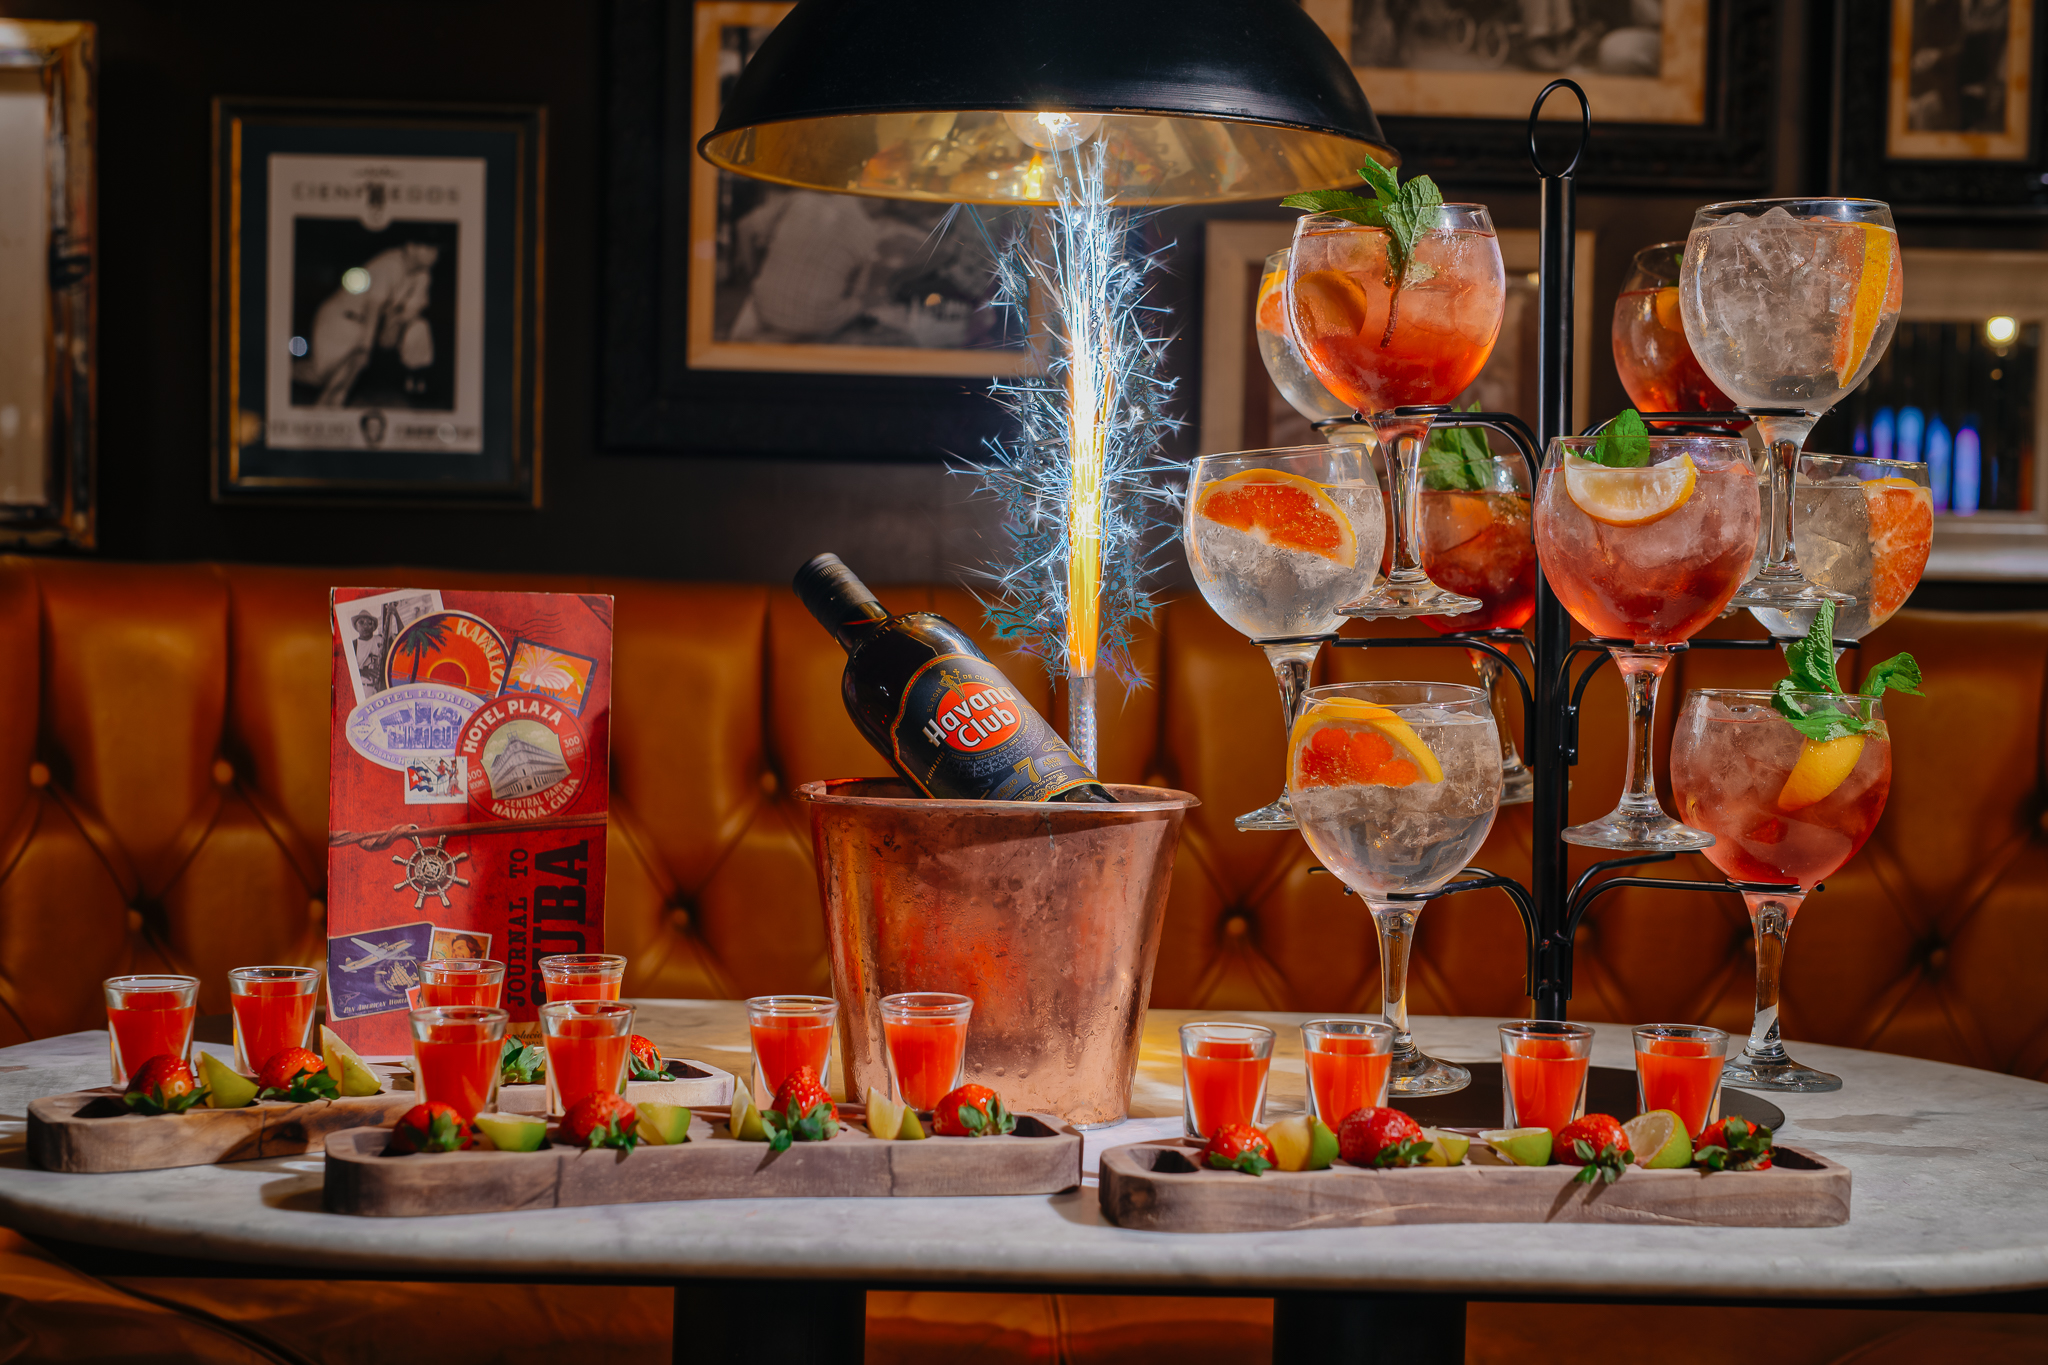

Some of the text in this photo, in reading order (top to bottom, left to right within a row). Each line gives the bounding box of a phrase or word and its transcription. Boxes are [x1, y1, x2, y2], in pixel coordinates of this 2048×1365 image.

[975, 674, 994, 684] CUBA
[365, 690, 480, 715] HOTEL FLORIDA
[930, 687, 943, 703] RON
[463, 699, 562, 754] HOTEL PLAZA
[922, 686, 1017, 748] Havana
[957, 706, 1017, 748] Club
[563, 735, 580, 749] 300
[566, 746, 584, 757] BATHS
[1012, 756, 1042, 784] 7
[469, 779, 486, 790] ROOMS
[504, 783, 566, 809] CENTRAL PARK
[550, 779, 580, 810] CUBA
[997, 778, 1019, 799] AÑEJO
[507, 848, 528, 1007] JOURNAL TO
[357, 1001, 386, 1011] AMERICAN
